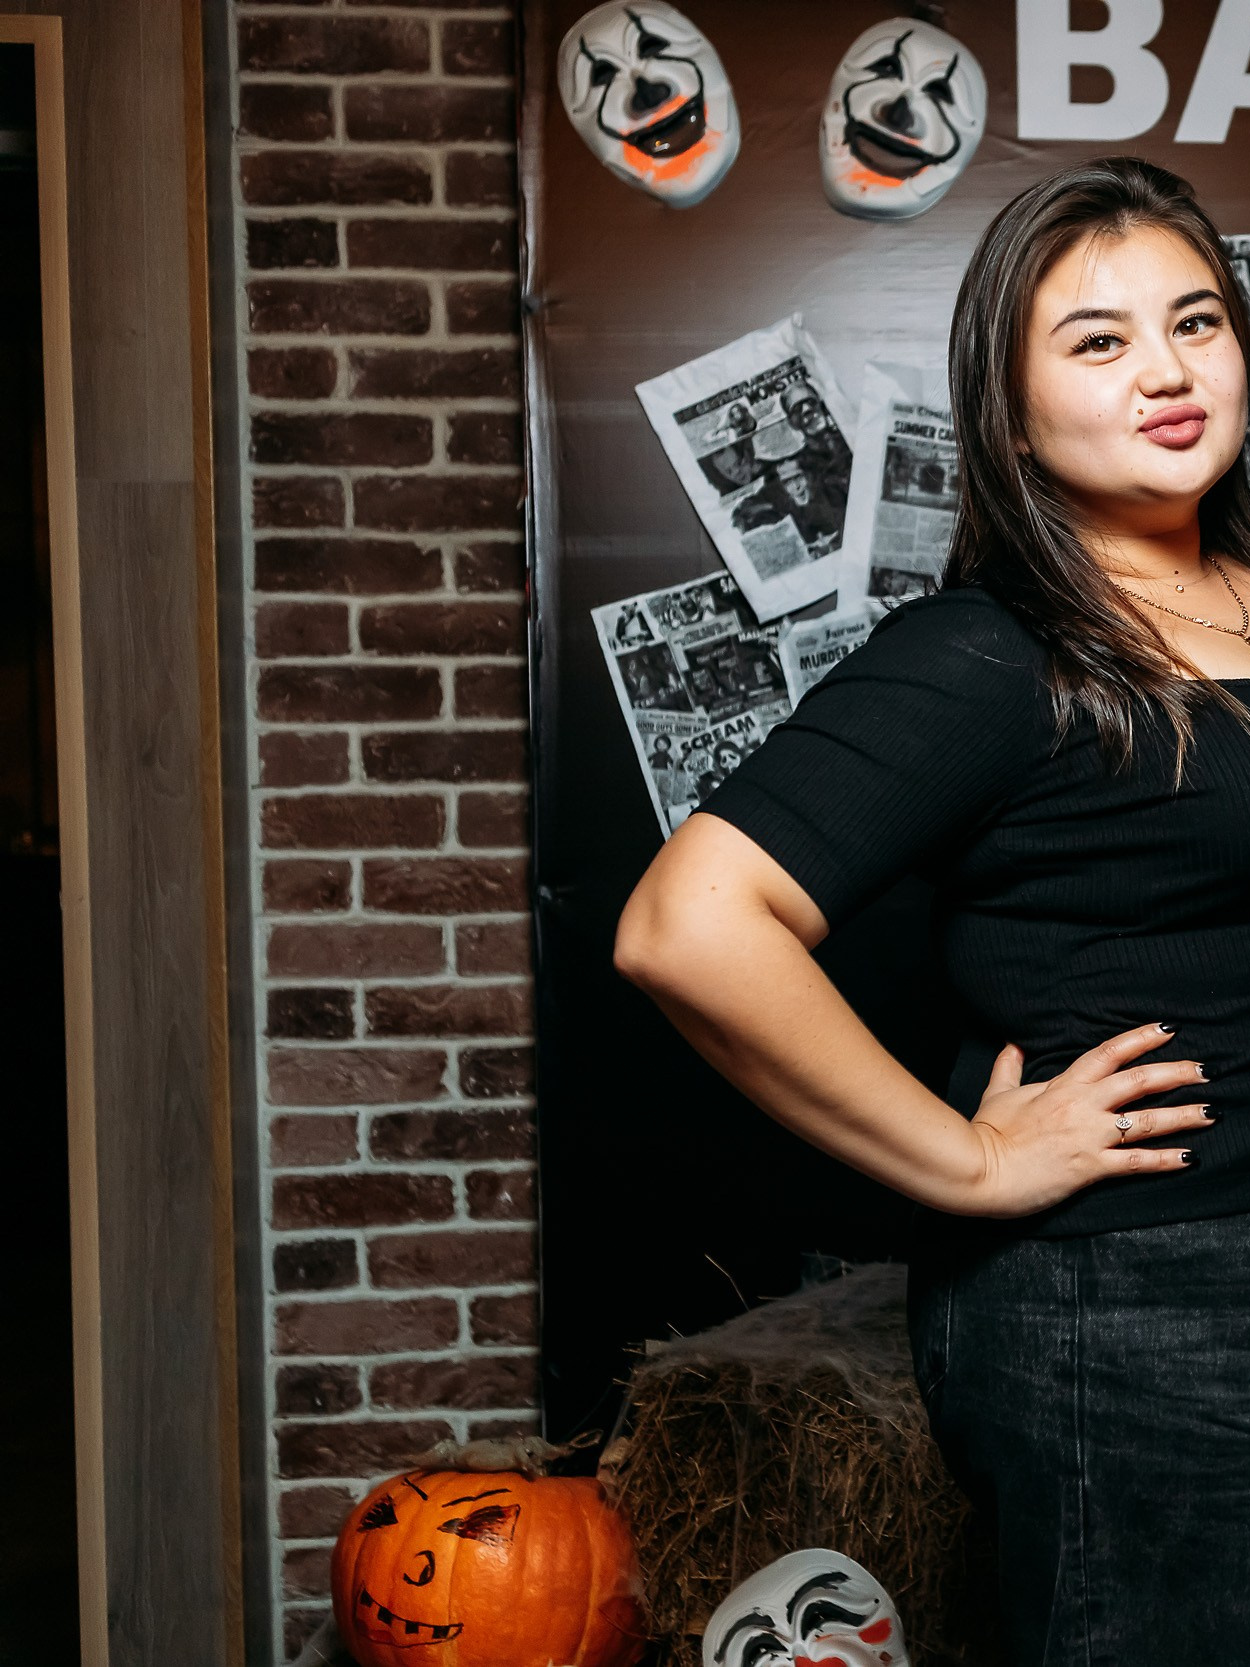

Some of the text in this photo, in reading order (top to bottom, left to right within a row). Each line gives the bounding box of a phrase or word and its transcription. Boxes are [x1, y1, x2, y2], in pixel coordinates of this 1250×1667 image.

[893, 419, 937, 440] SUMMER
[799, 645, 850, 671] MURDER
[680, 714, 756, 752] SCREAM
